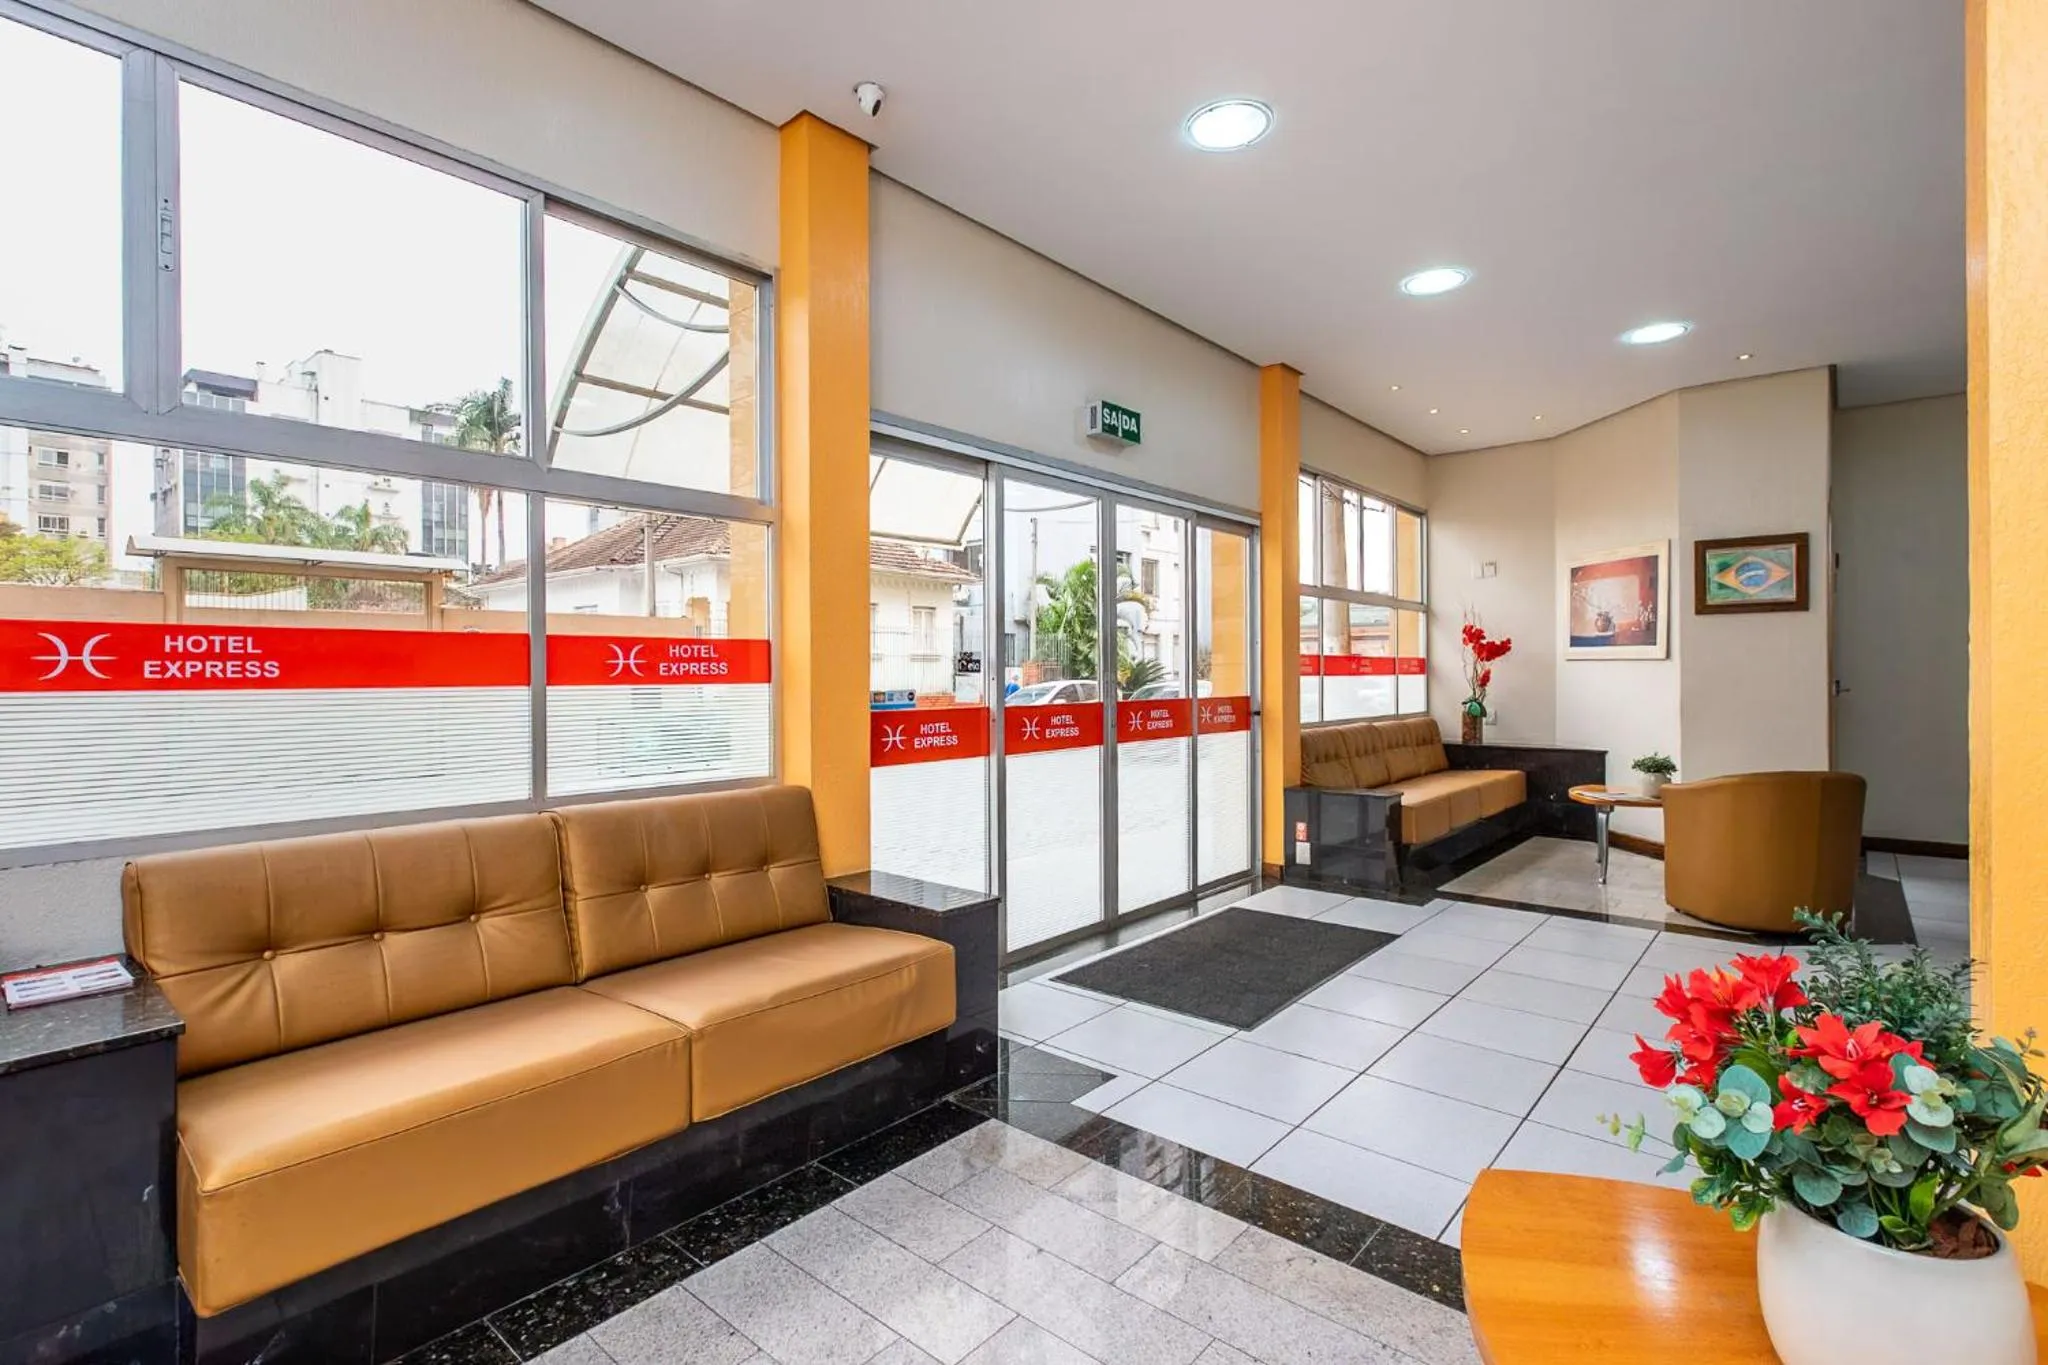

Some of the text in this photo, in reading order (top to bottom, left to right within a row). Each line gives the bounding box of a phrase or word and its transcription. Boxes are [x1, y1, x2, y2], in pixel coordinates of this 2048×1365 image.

[164, 635, 262, 654] HOTEL
[669, 644, 719, 658] HOTEL
[143, 660, 281, 679] EXPRESS
[659, 662, 729, 676] EXPRESS
[1050, 715, 1075, 725] HOTEL
[920, 722, 952, 734] HOTEL
[1045, 727, 1079, 738] EXPRESS
[914, 736, 958, 749] EXPRESS
